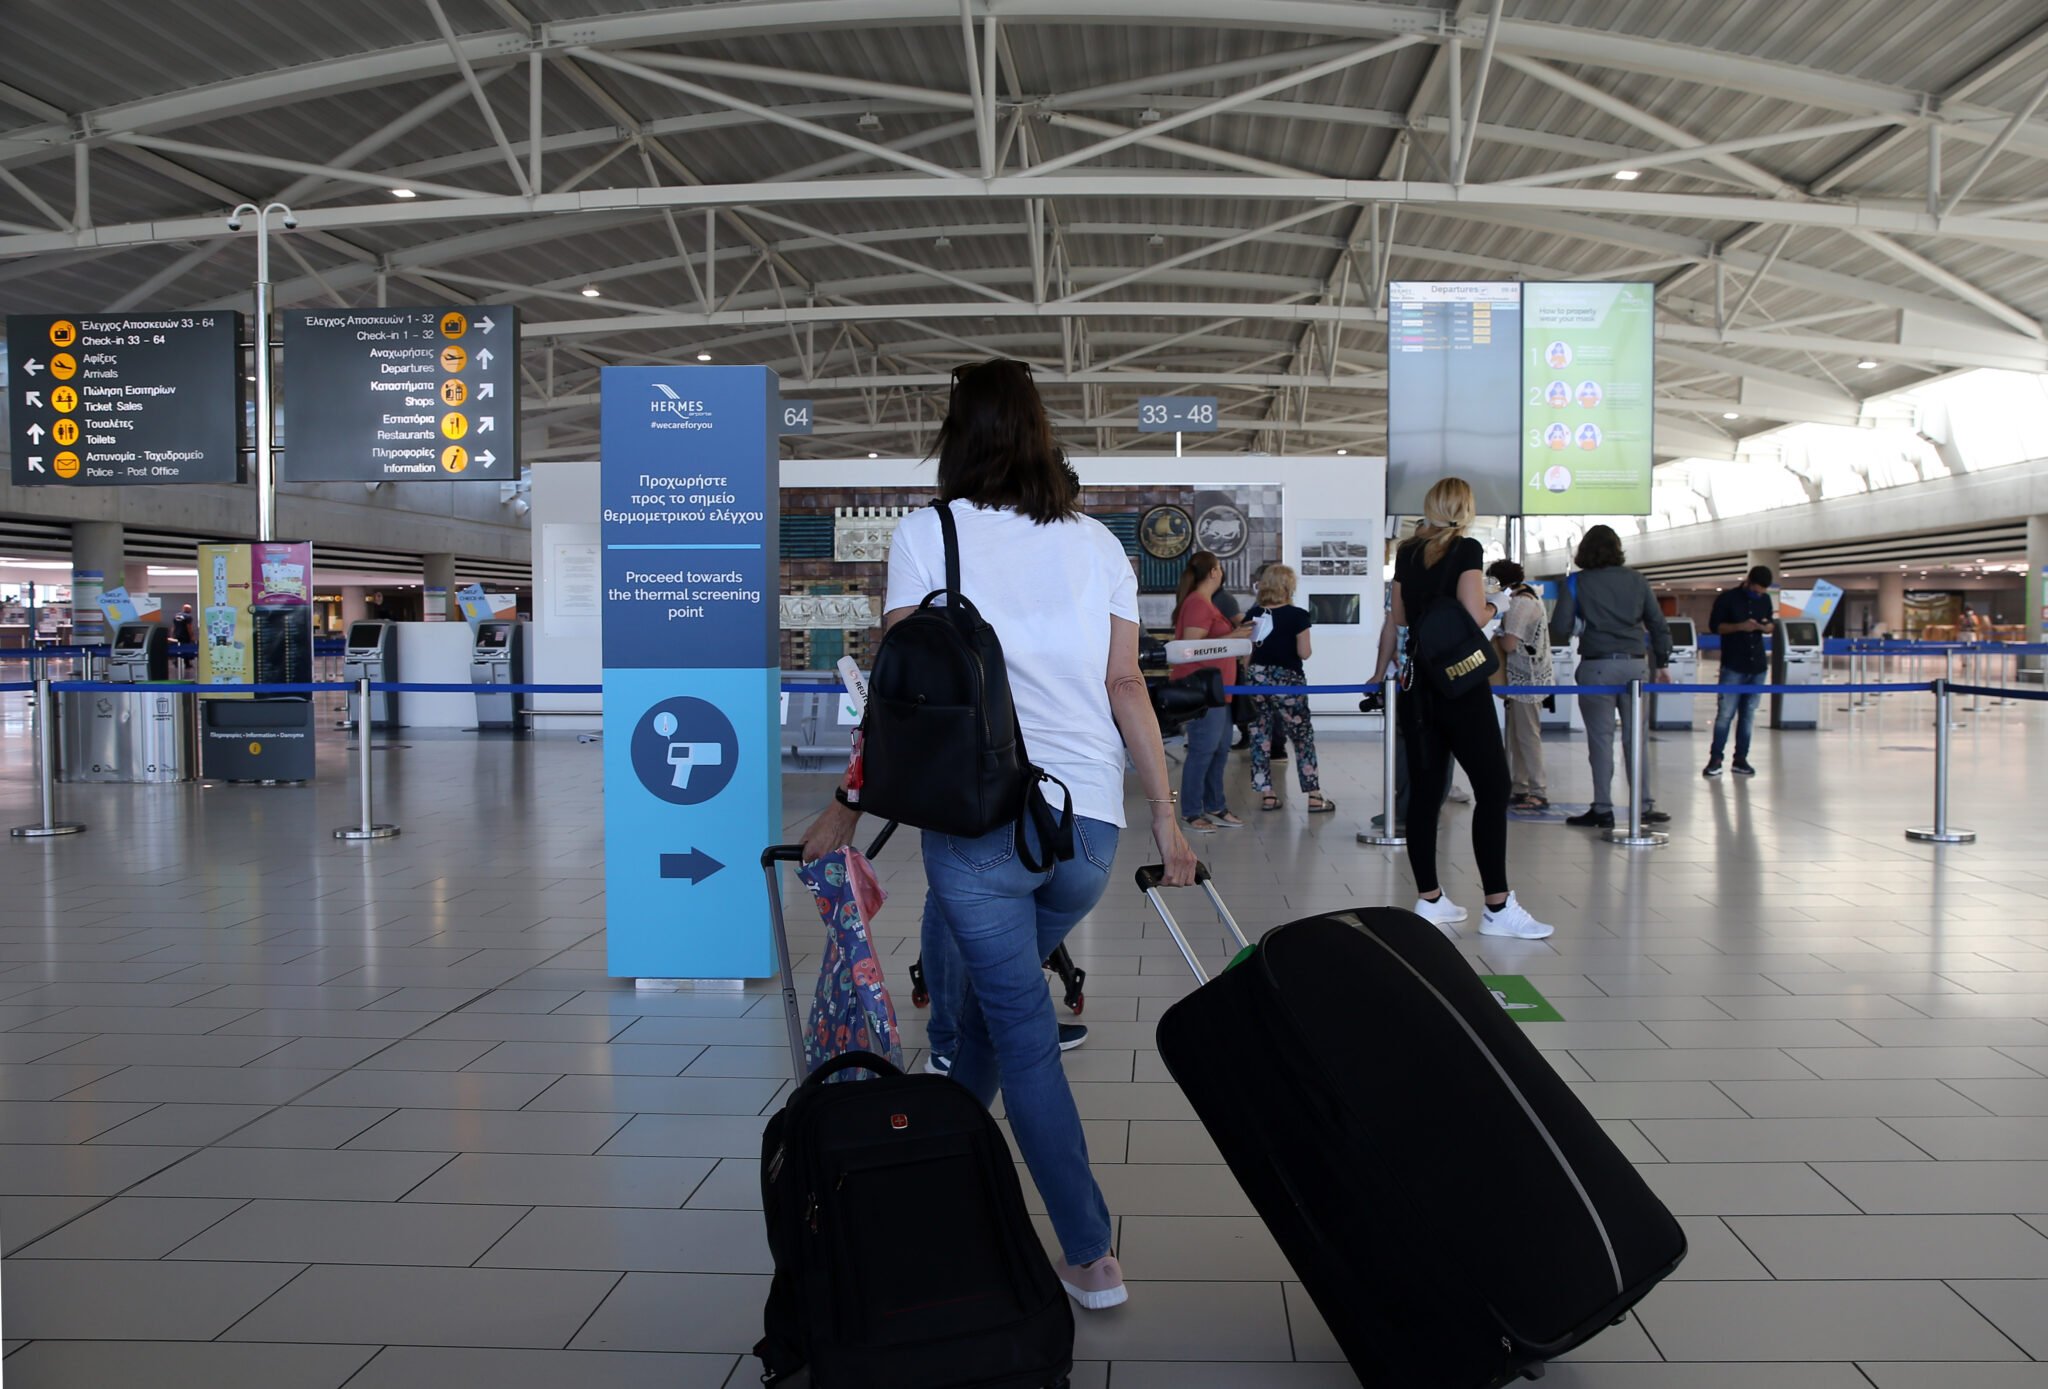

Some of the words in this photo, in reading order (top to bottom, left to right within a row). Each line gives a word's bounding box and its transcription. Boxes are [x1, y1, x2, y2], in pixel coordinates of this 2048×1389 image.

[1431, 285, 1479, 294] Departures
[80, 320, 121, 332] Έλεγχος
[122, 318, 179, 329] Αποσκευών
[181, 318, 194, 328] 33
[202, 318, 215, 328] 64
[305, 316, 345, 327] Έλεγχος
[347, 314, 404, 325] Αποσκευών
[407, 314, 412, 324] 1
[422, 314, 434, 323] 32
[81, 336, 125, 346] Check-in
[127, 336, 140, 345] 33
[153, 335, 166, 345] 64
[356, 331, 399, 341] Check-in
[404, 331, 408, 339] 1
[422, 330, 434, 339] 32
[83, 353, 117, 365] Αφίξεις
[369, 347, 434, 359] Αναχωρήσεις
[1531, 347, 1538, 366] 1
[83, 369, 119, 379] Arrivals
[381, 363, 435, 375] Departures
[83, 386, 123, 397] Πώληση
[125, 385, 176, 397] Εισιτηρίων
[370, 381, 435, 392] Καταστήματα
[405, 396, 435, 408] Shops
[1529, 386, 1542, 406] 2
[84, 402, 112, 412] Ticket
[116, 401, 143, 411] Sales
[650, 400, 704, 416] HERMES
[383, 414, 435, 425] Εστιατόρια
[784, 407, 809, 426] 64
[1142, 404, 1168, 424] 33
[1186, 404, 1213, 424] 48
[85, 419, 134, 430] Τουαλέτες
[651, 421, 713, 431] #wecareforyou
[85, 434, 116, 445] Toilets
[377, 430, 435, 440] Restaurants
[1529, 428, 1541, 448] 3
[86, 451, 136, 463] Αστυνομία
[143, 450, 204, 462] Ταχυδρομείο
[372, 447, 436, 459] Πληροφορίες
[86, 467, 114, 477] Police
[127, 466, 147, 476] Post
[151, 466, 180, 476] Office
[383, 463, 436, 473] Information
[639, 473, 728, 490] Προχωρήστε
[1528, 471, 1541, 490] 4
[631, 493, 666, 506] προς
[669, 493, 687, 504] το
[689, 491, 736, 507] σημείο
[603, 508, 706, 524] θερμομετρικού
[709, 508, 764, 524] ελέγχου
[625, 570, 684, 584] Proceed
[686, 570, 743, 584] towards
[608, 588, 632, 601] the
[634, 588, 690, 601] thermal
[691, 588, 761, 604] screening
[668, 606, 705, 621] point
[1193, 645, 1228, 656] REUTERS
[1444, 649, 1487, 681] PUMA
[855, 680, 869, 704] REUTE
